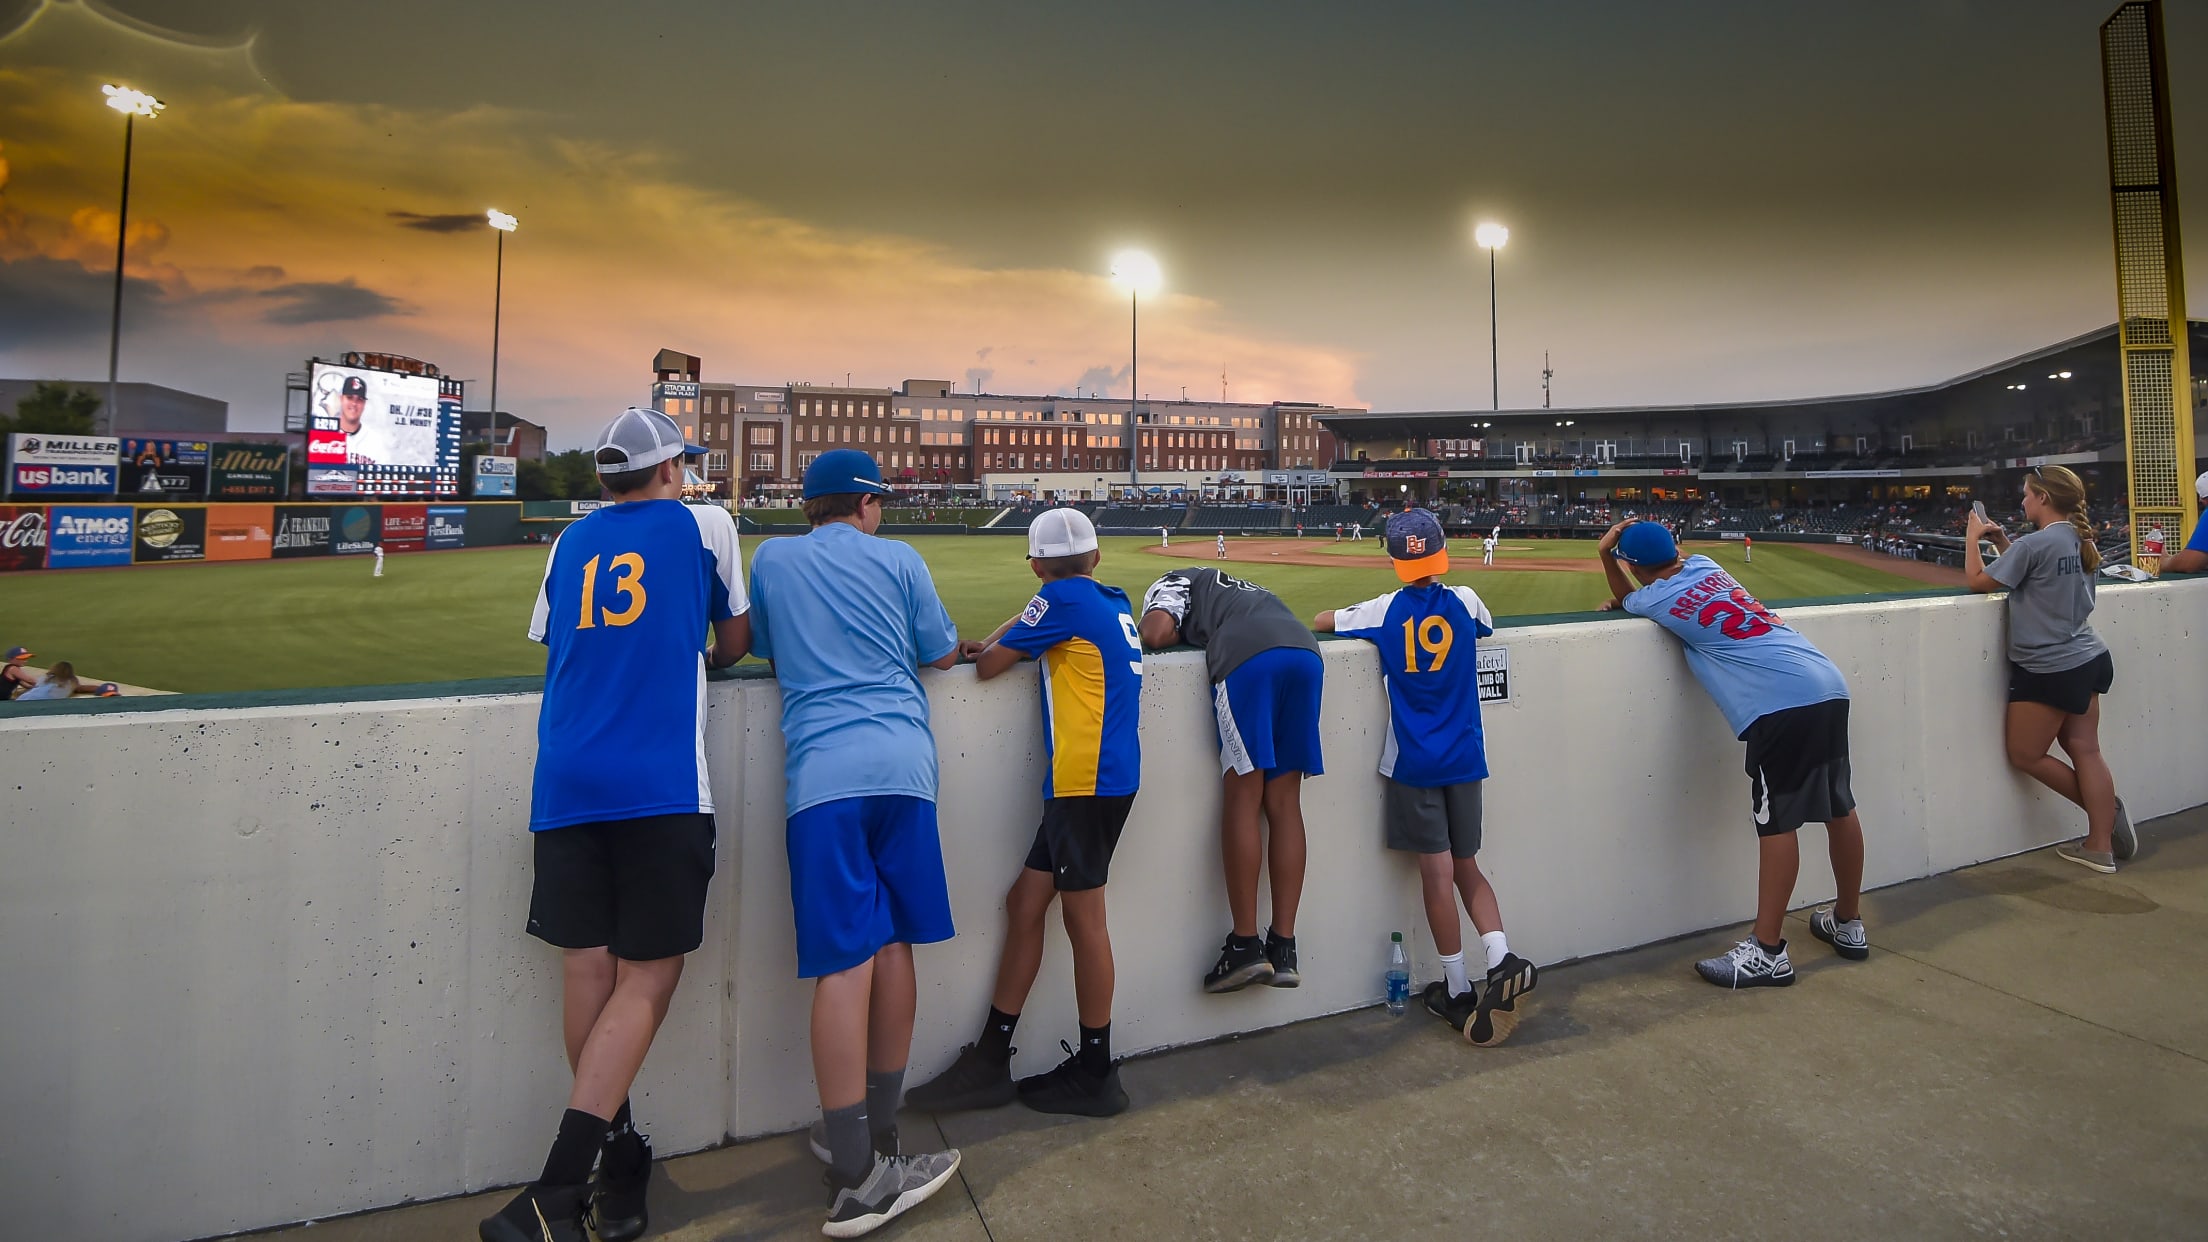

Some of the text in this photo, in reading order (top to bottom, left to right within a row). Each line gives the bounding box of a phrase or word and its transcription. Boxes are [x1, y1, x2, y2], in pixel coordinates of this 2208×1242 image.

[664, 384, 696, 393] STADIUM
[46, 440, 118, 450] MILLER
[220, 450, 287, 471] Mint
[56, 516, 129, 534] ATMOS
[291, 517, 330, 532] FRANKLIN
[76, 534, 128, 544] energy
[576, 552, 647, 630] 13
[1402, 615, 1454, 672] 19
[1477, 654, 1504, 670] afety!
[1478, 672, 1504, 686] LIMB OR
